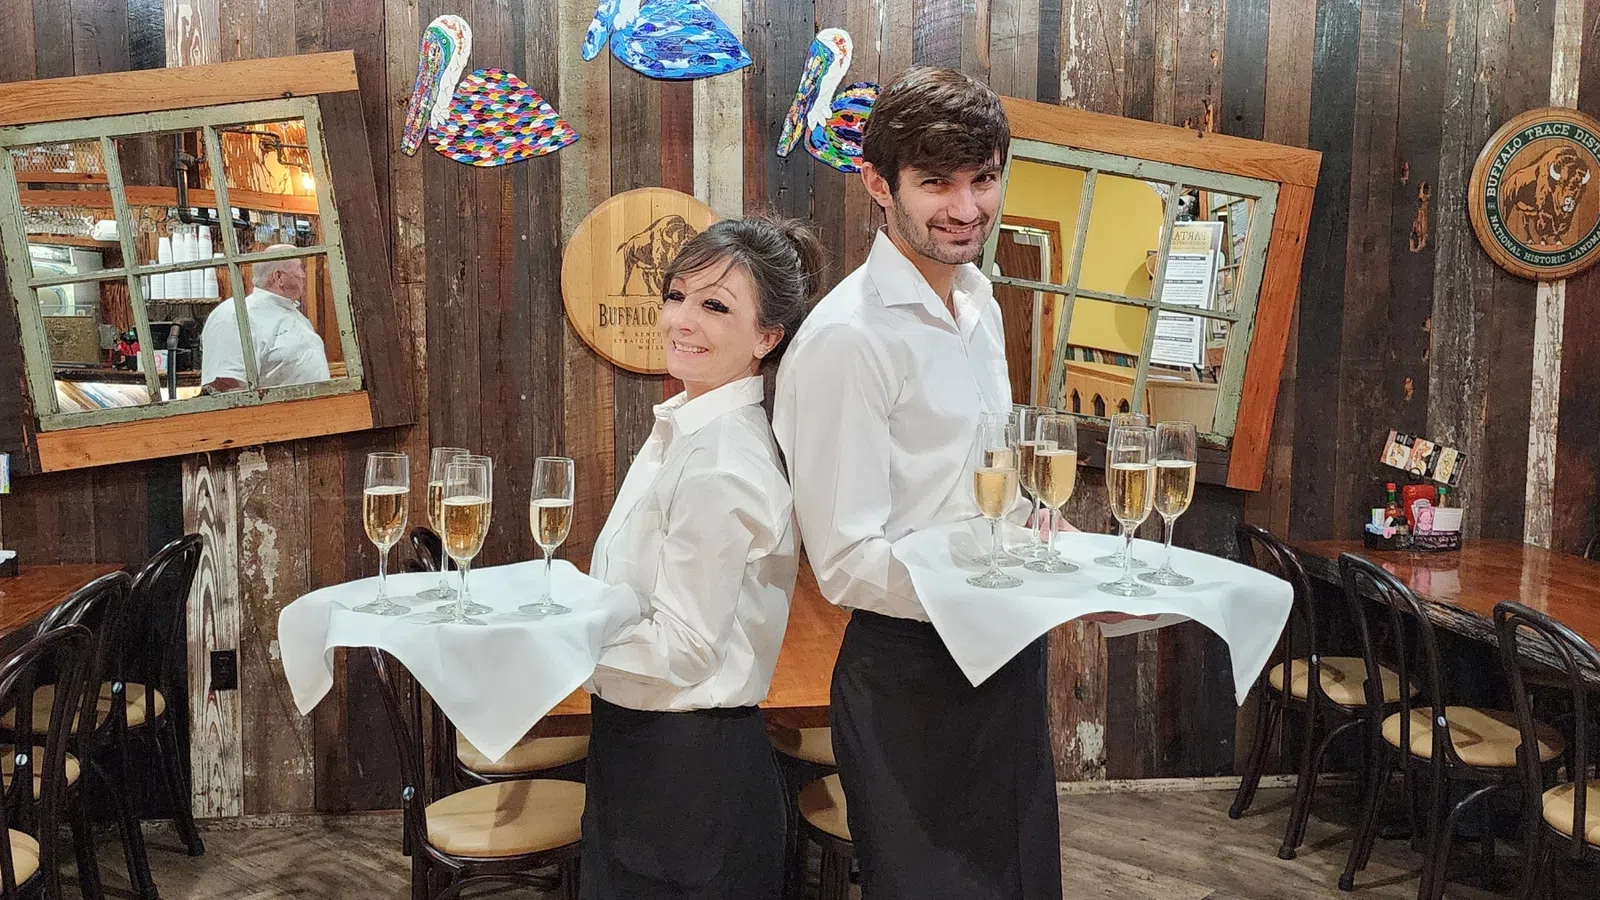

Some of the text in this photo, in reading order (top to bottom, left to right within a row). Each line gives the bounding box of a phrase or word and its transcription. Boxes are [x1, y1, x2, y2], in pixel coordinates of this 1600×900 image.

[1487, 125, 1600, 197] BUFFALO TRACE DIST
[1490, 215, 1600, 264] NATIONAL HISTORIC LANDMA
[599, 304, 657, 327] BUFFALO
